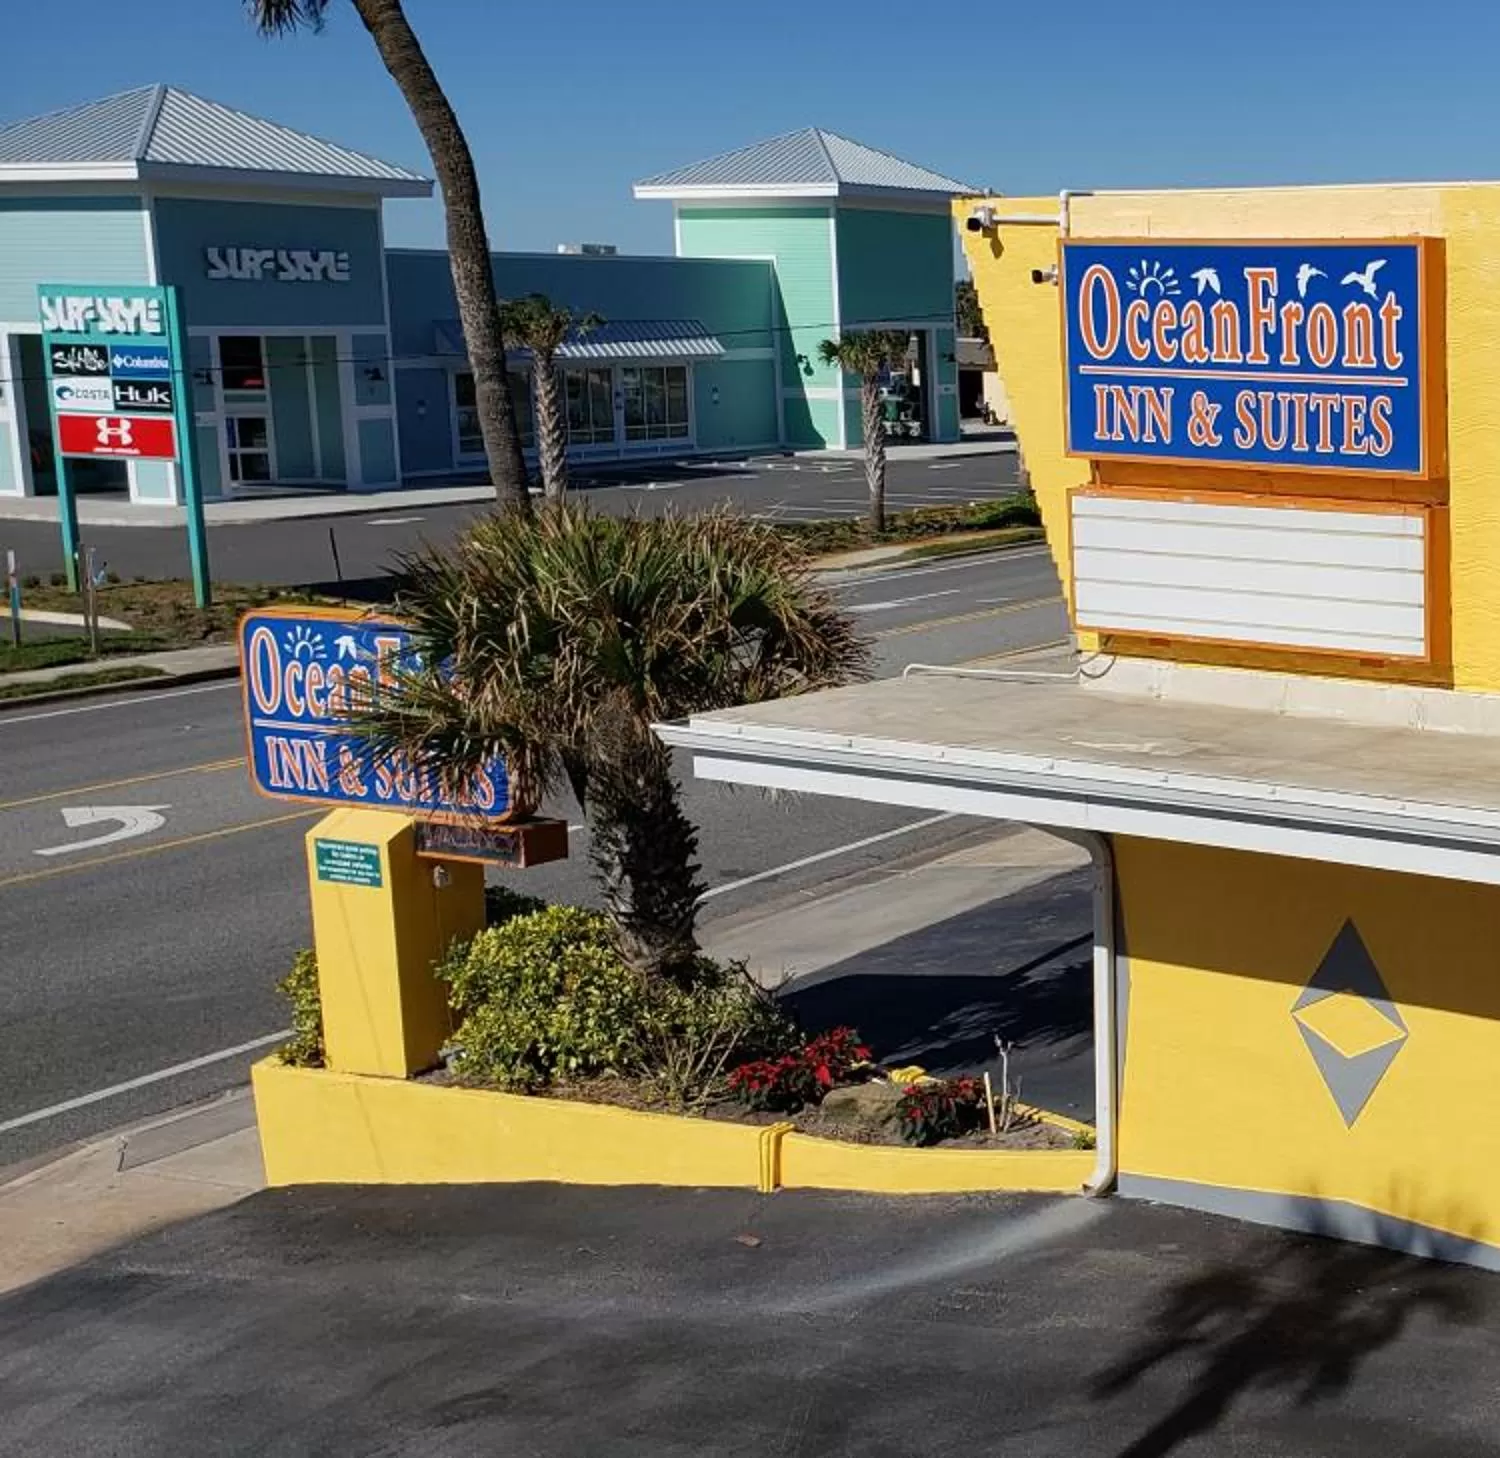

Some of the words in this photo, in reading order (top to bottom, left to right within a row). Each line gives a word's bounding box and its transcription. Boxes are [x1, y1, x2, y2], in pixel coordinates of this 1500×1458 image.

[1079, 263, 1404, 370] OceanFront
[1093, 384, 1174, 444] INN
[1187, 391, 1223, 447] &
[1233, 391, 1395, 457] SUITES
[249, 626, 408, 720] OceanF
[264, 735, 330, 793] INN
[339, 744, 368, 798] &
[373, 743, 496, 810] SUIS
